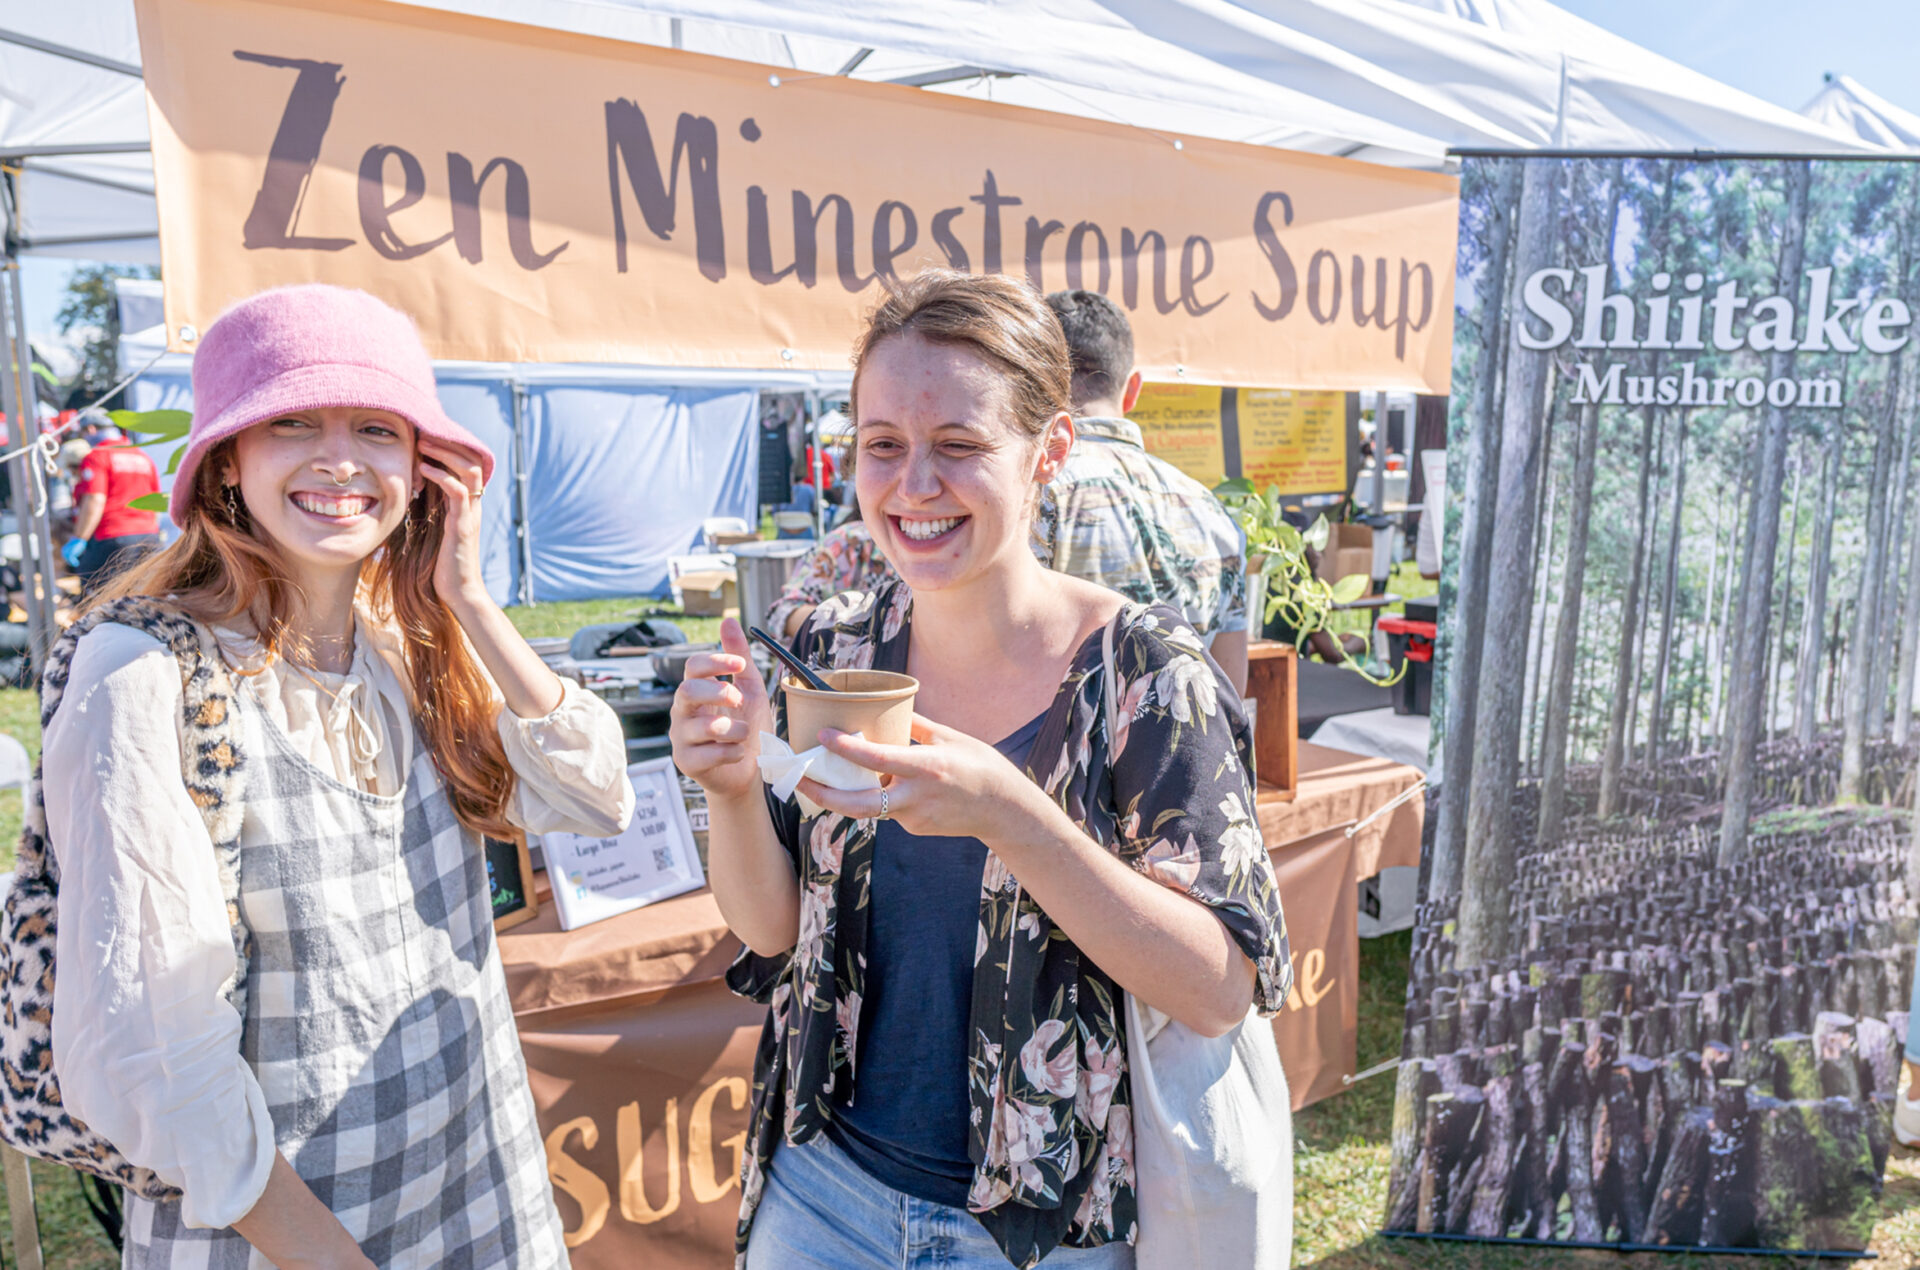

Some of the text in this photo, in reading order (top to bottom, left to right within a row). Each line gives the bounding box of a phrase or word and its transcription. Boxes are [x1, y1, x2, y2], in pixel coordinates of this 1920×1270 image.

[233, 50, 1434, 363] Zen Minestrone Soup
[1518, 263, 1912, 354] Shiitake
[1570, 362, 1843, 408] Mushroom
